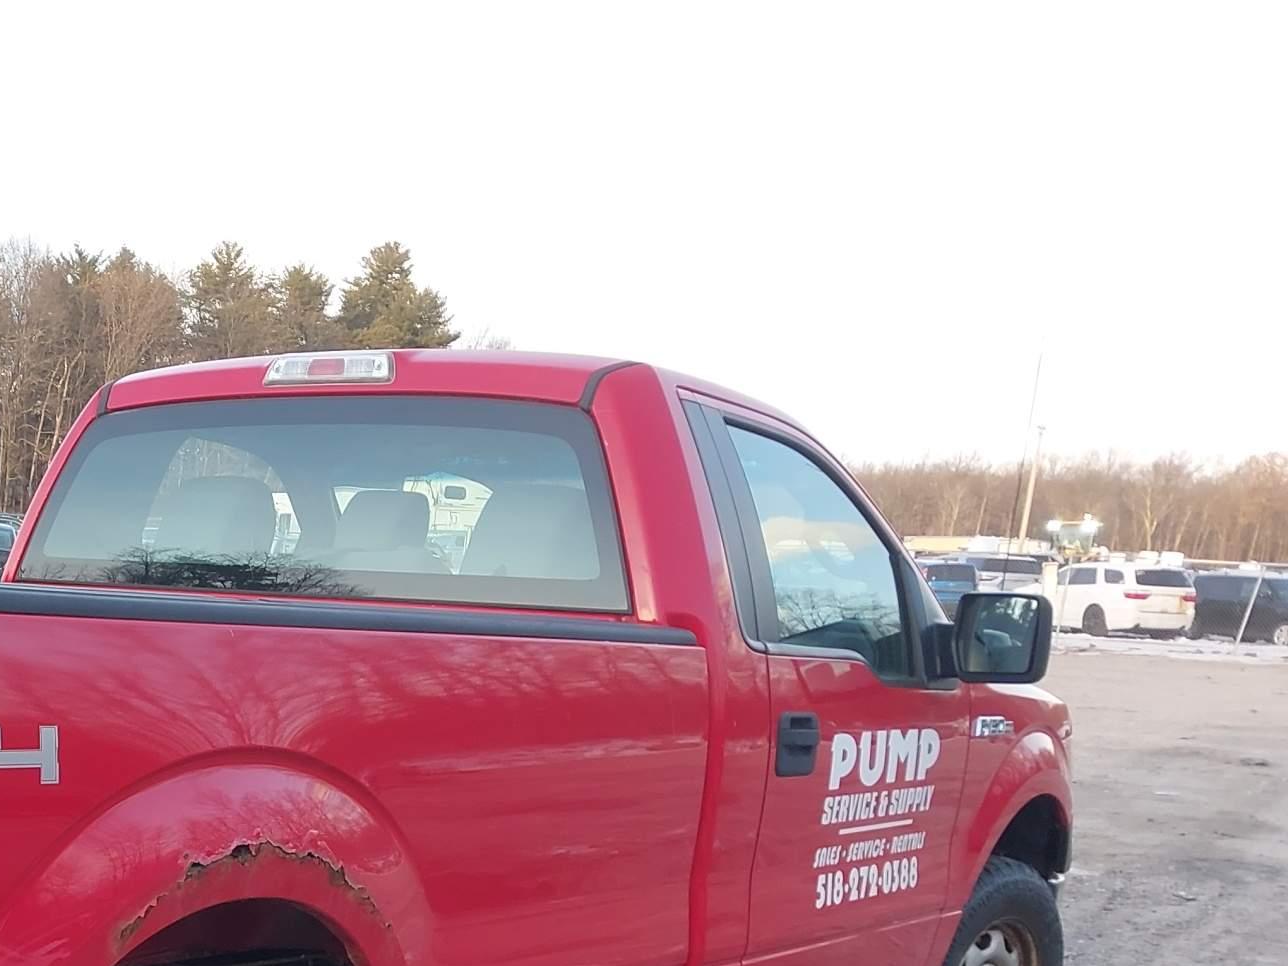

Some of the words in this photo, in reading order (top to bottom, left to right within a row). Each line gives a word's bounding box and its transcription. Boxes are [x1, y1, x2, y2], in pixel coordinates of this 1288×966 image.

[828, 728, 941, 791] PUMP
[821, 792, 879, 825] SERVICE
[878, 790, 889, 817] &
[889, 785, 935, 816] SUPPLY
[813, 846, 842, 869] SALES
[846, 838, 886, 863] SERVICE
[890, 831, 926, 854] RENTALS
